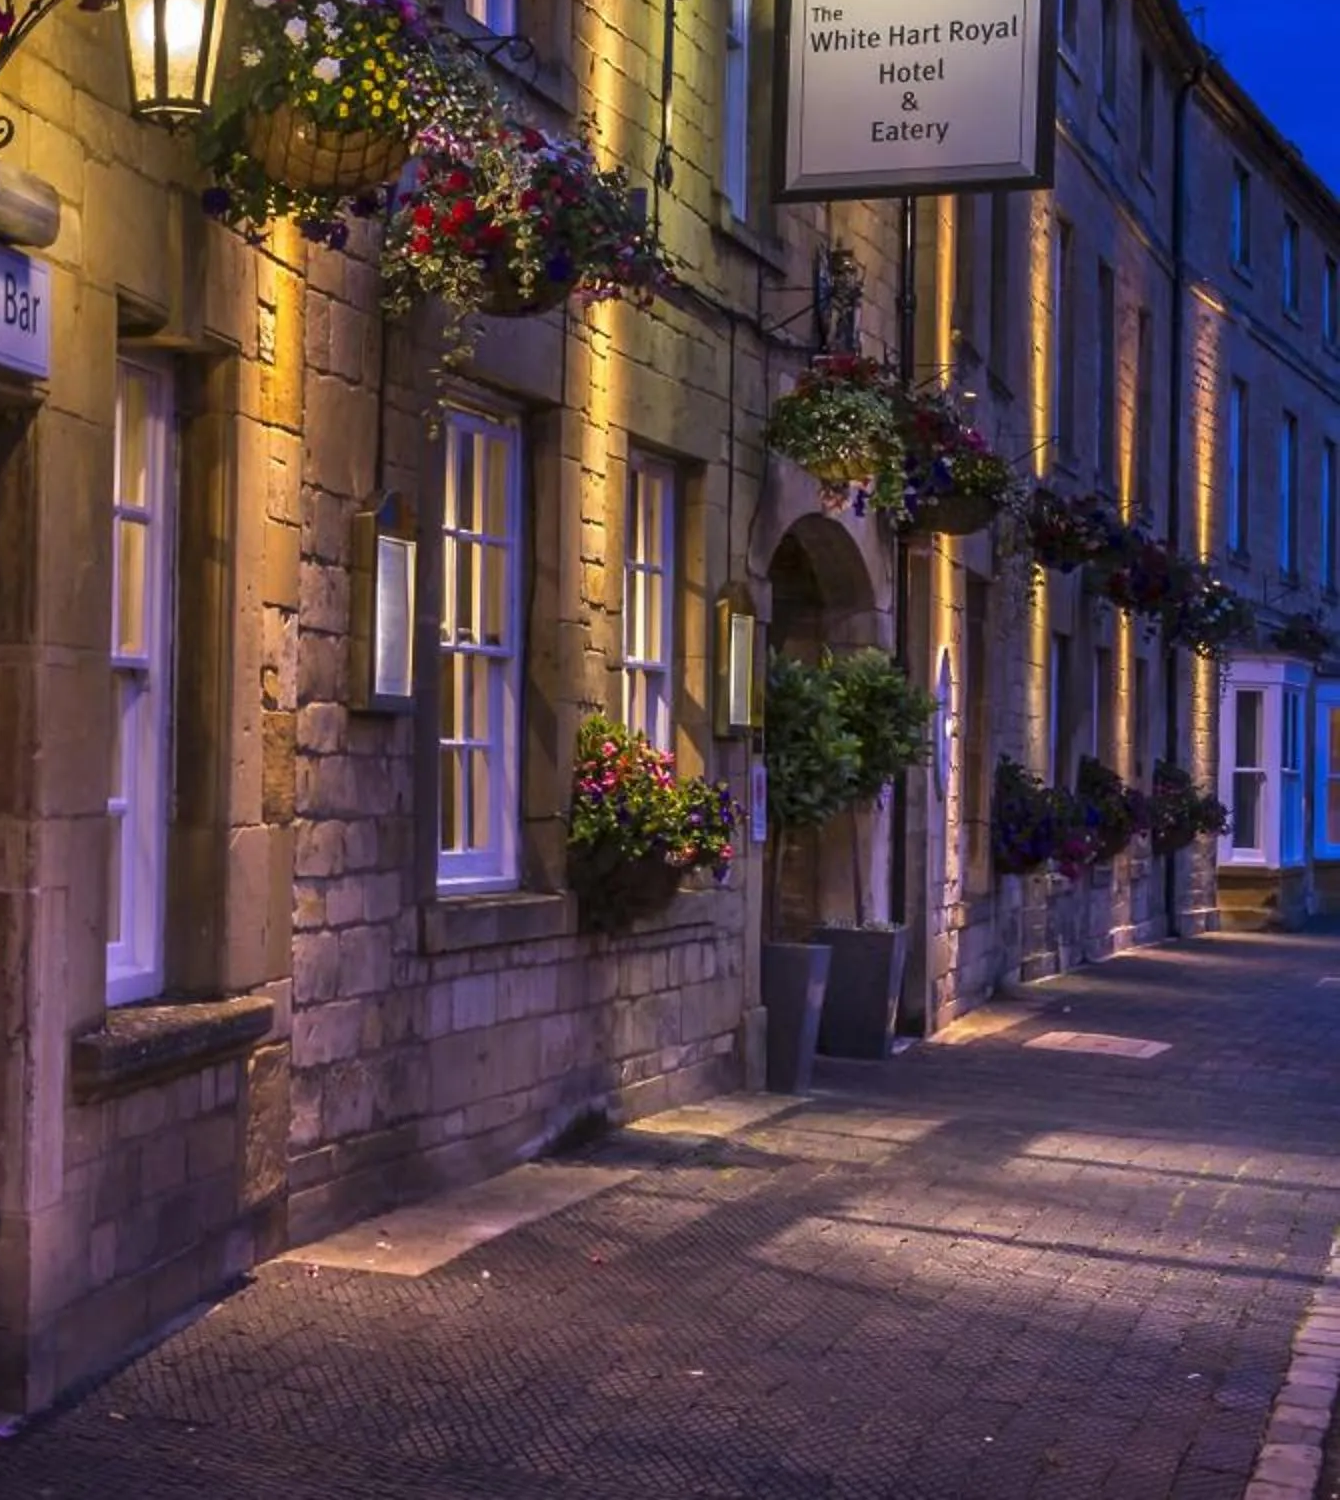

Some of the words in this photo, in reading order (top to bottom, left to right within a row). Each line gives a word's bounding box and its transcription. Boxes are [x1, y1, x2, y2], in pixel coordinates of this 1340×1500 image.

[811, 7, 844, 23] The
[811, 30, 881, 54] White
[888, 23, 941, 47] Hart
[949, 15, 1018, 46] Royal
[878, 58, 945, 86] Hotel
[901, 91, 919, 112] &
[871, 120, 950, 144] Eatery
[4, 272, 41, 335] Bar
